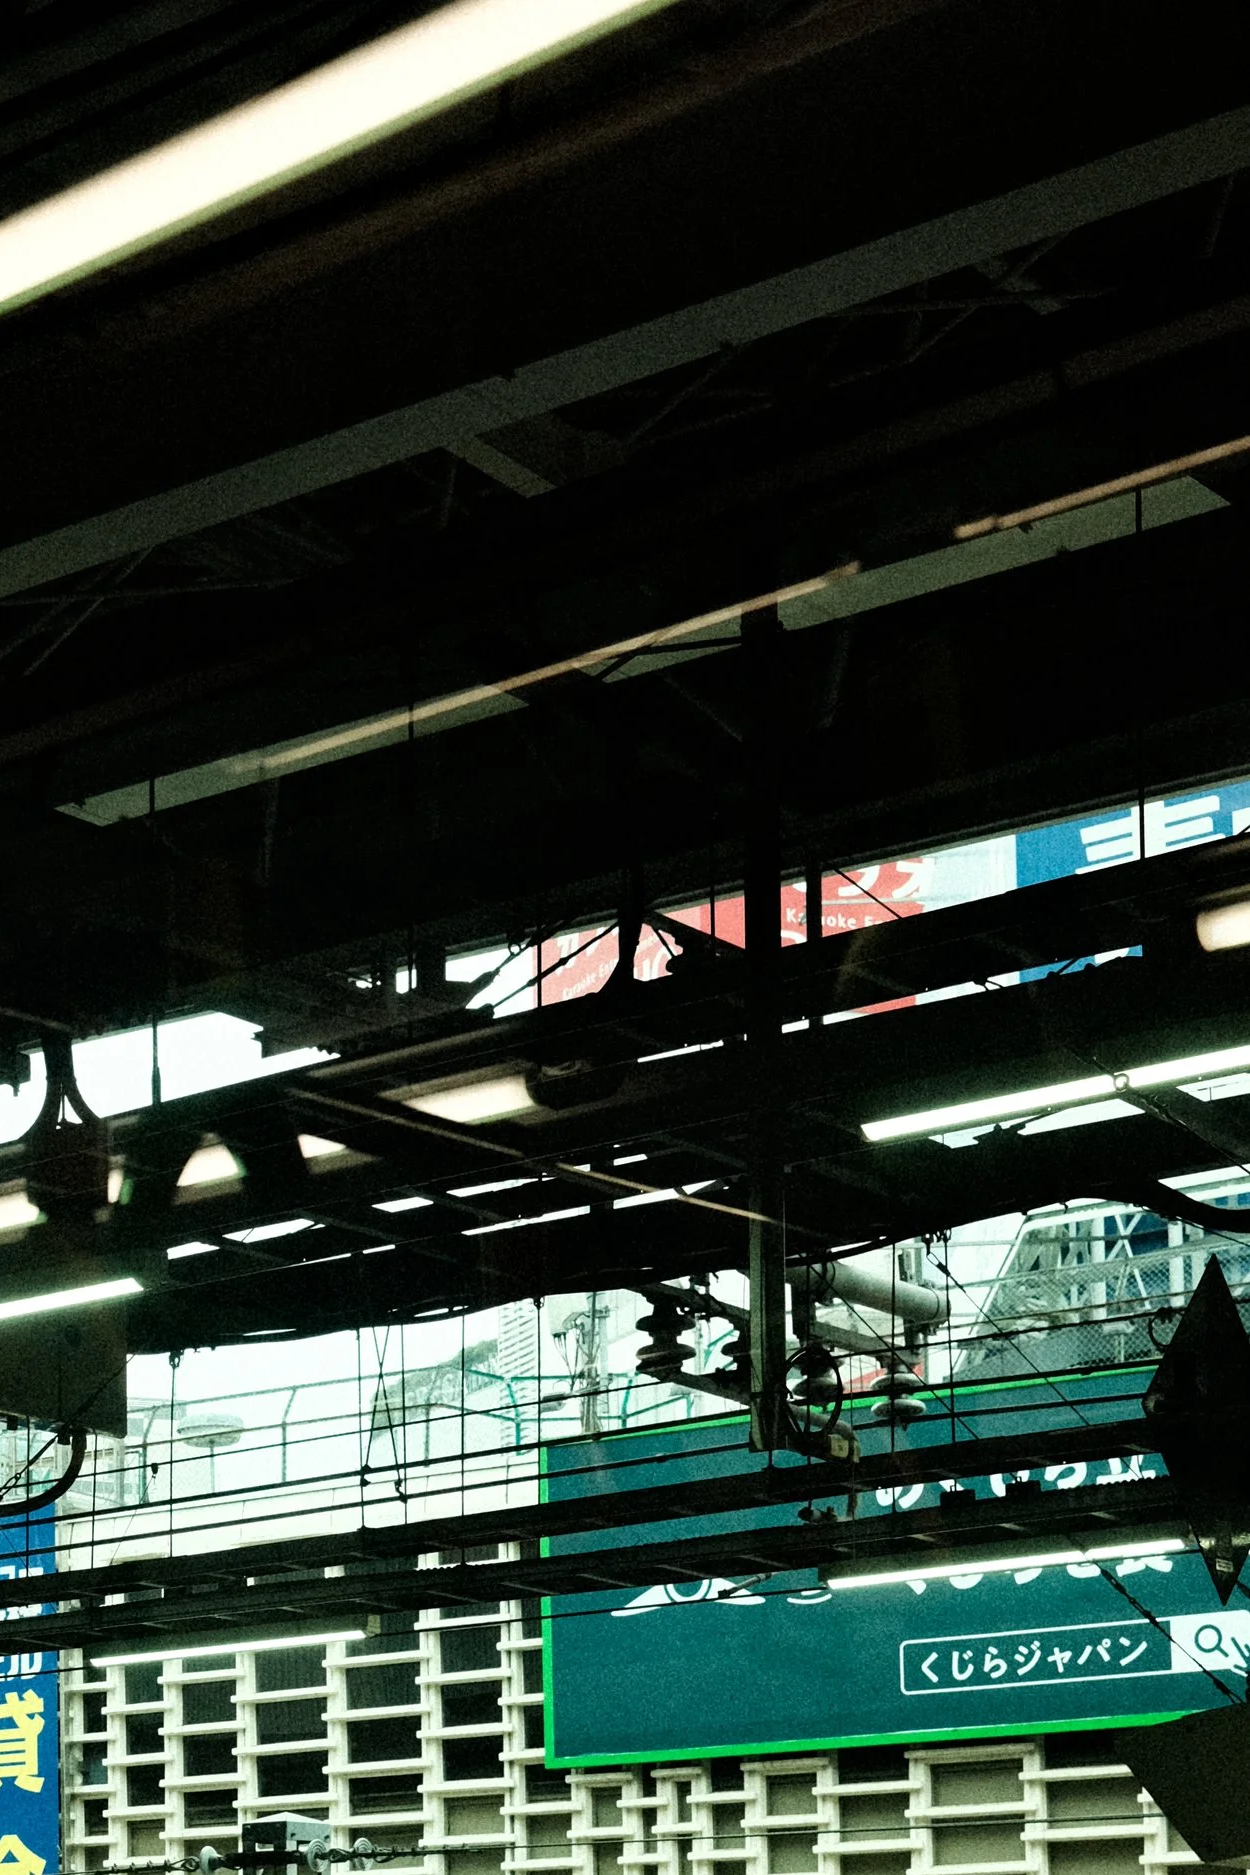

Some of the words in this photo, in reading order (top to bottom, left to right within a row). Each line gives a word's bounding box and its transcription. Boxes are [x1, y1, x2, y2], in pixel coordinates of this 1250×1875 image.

[920, 1636, 1148, 1684] くじらジャパン
